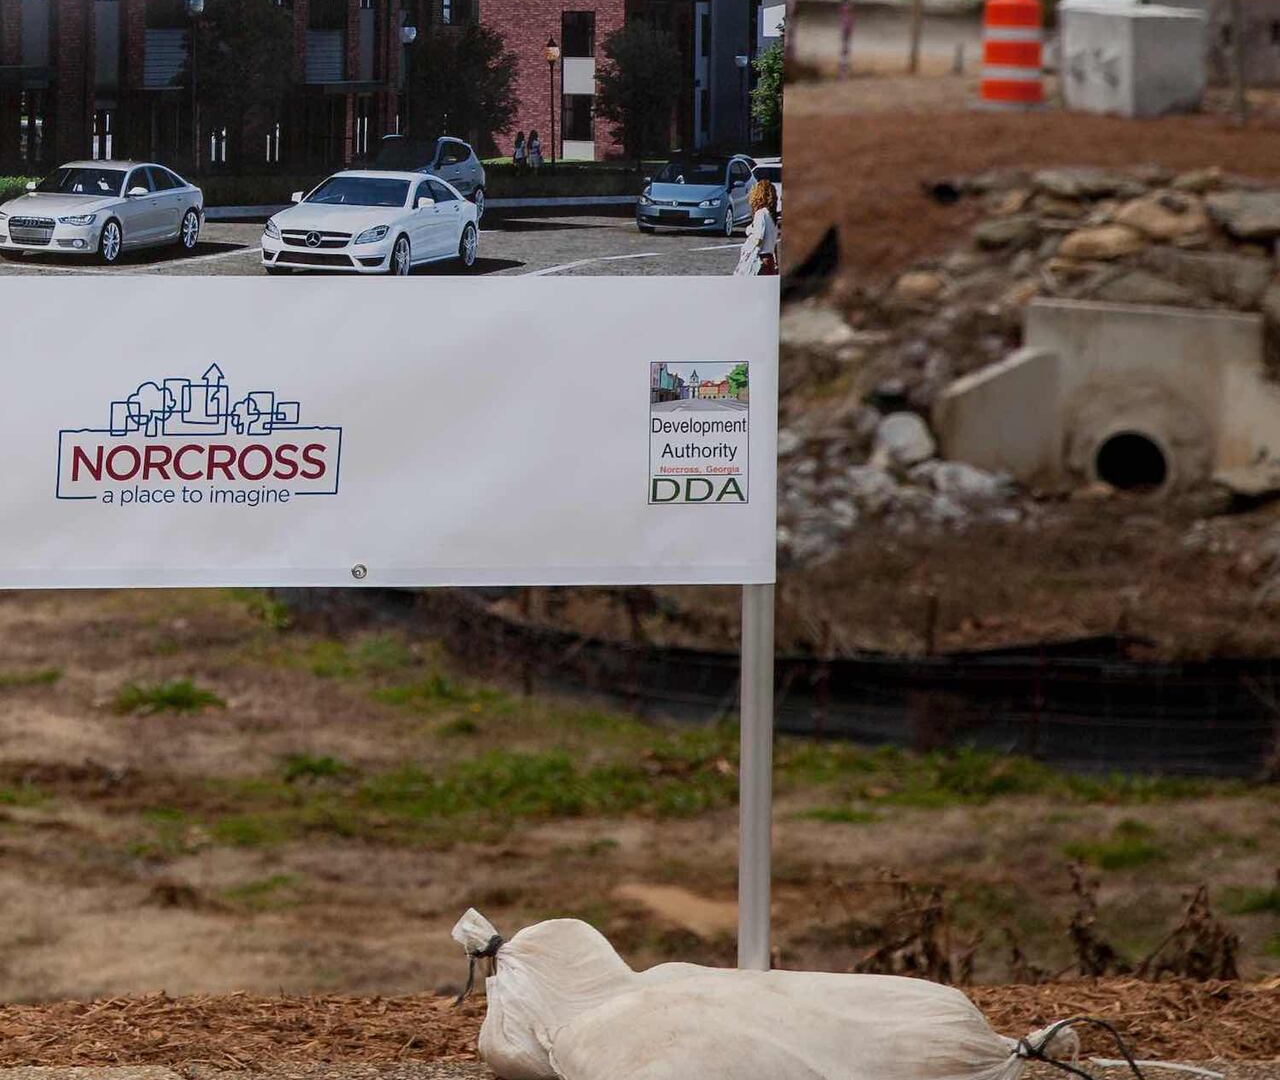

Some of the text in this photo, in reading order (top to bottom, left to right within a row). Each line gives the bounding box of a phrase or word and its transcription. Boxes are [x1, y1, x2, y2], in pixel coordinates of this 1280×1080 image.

[651, 417, 747, 437] Development
[71, 444, 327, 482] NORCROSS
[661, 442, 738, 462] Authority
[102, 485, 290, 507] a place to imagine
[651, 477, 746, 502] DDA
